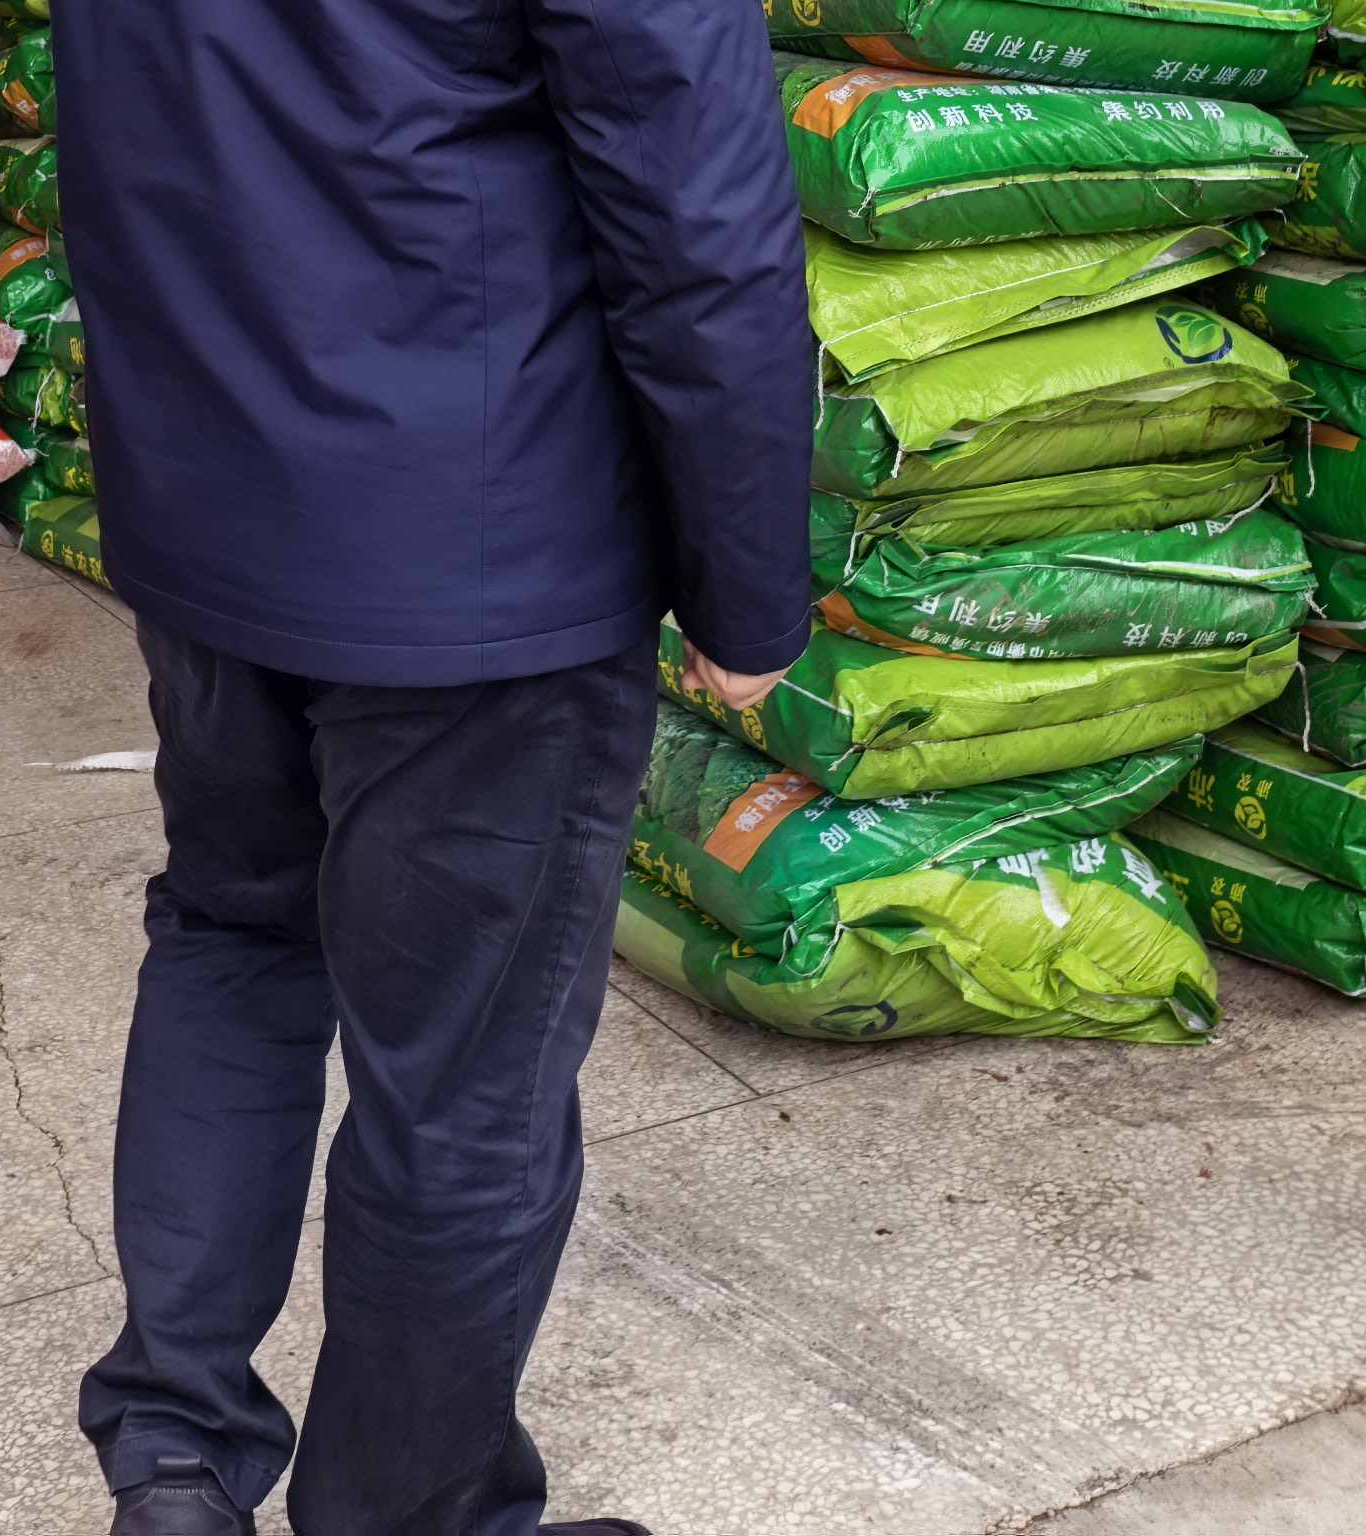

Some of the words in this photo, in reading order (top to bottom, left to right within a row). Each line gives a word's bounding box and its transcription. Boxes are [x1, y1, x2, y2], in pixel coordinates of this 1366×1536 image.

[963, 29, 1091, 68] 集约利用
[1150, 58, 1268, 88] 创新科技
[905, 102, 1039, 132] 创新科技
[1101, 99, 1226, 123] 集约利用
[973, 836, 1168, 928] 有机肥
